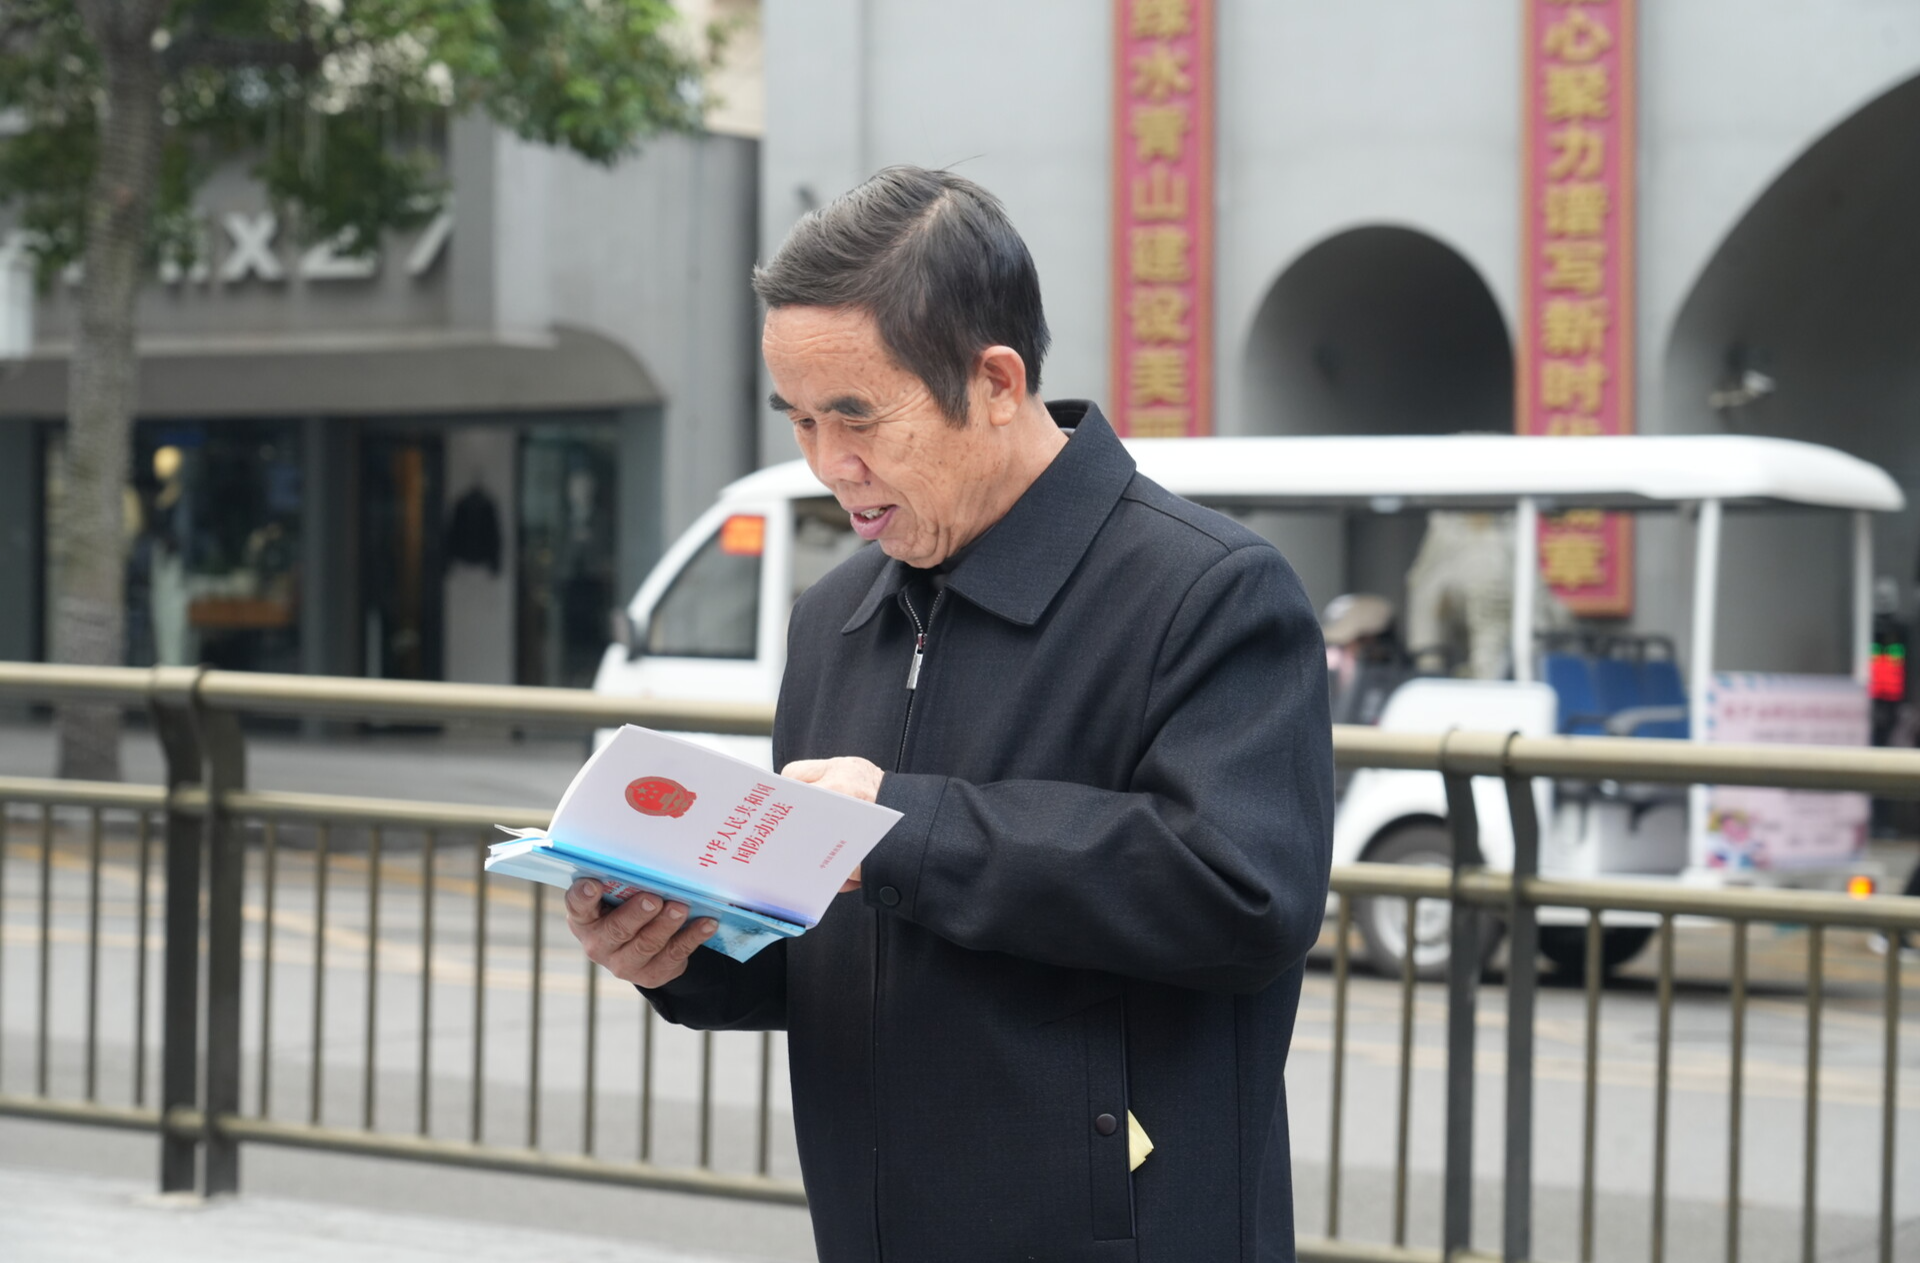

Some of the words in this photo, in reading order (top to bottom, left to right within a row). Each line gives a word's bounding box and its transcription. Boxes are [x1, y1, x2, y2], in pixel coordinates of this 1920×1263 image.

[699, 783, 776, 867] 中华人民共和国
[731, 802, 794, 864] 国防动员法
